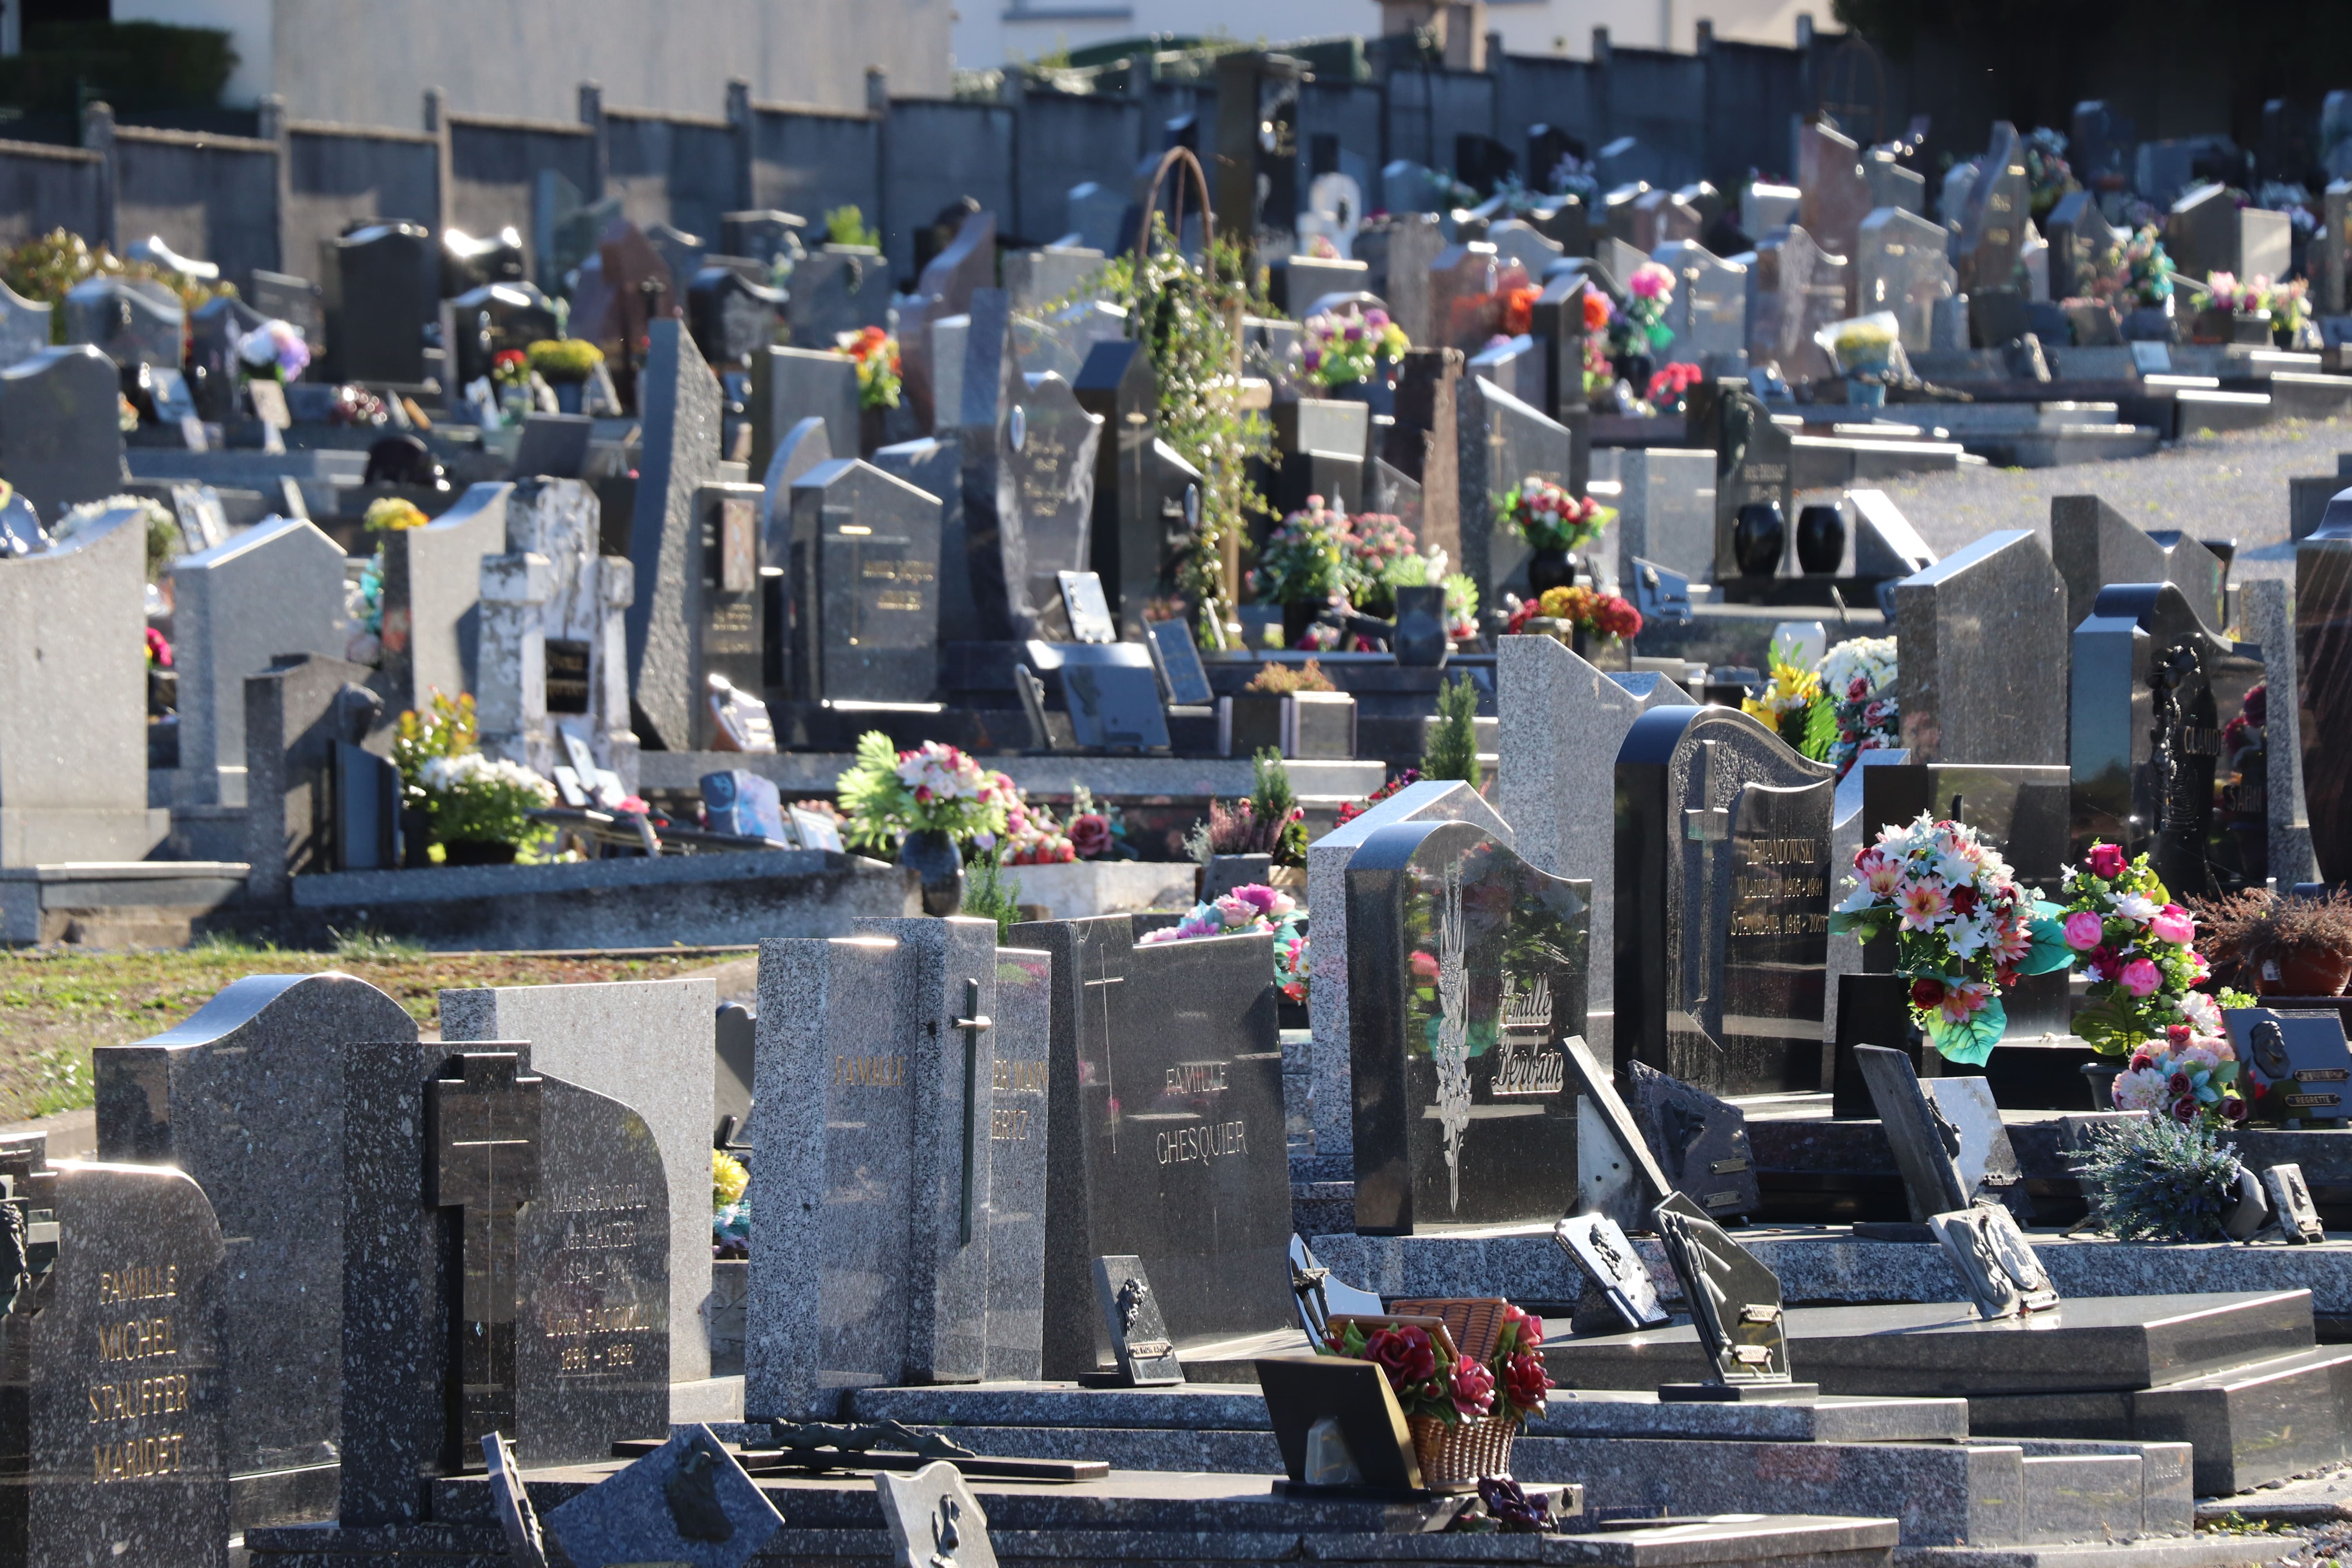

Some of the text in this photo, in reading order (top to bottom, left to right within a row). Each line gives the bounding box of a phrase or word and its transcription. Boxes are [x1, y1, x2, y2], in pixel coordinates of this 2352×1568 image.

[2184, 726, 2224, 756] CLAUD
[1496, 970, 1552, 1037] Famille
[835, 1055, 905, 1086] FAMILLE
[1166, 1062, 1229, 1096] FAMILLE
[991, 1109, 1029, 1140] ERTZ
[1156, 1120, 1249, 1166] GHESQUIER
[100, 1264, 176, 1305] FAMILLE
[99, 1316, 177, 1363] MICHEL
[89, 1374, 189, 1424] STAUFFER
[93, 1432, 184, 1485] MARIDET
